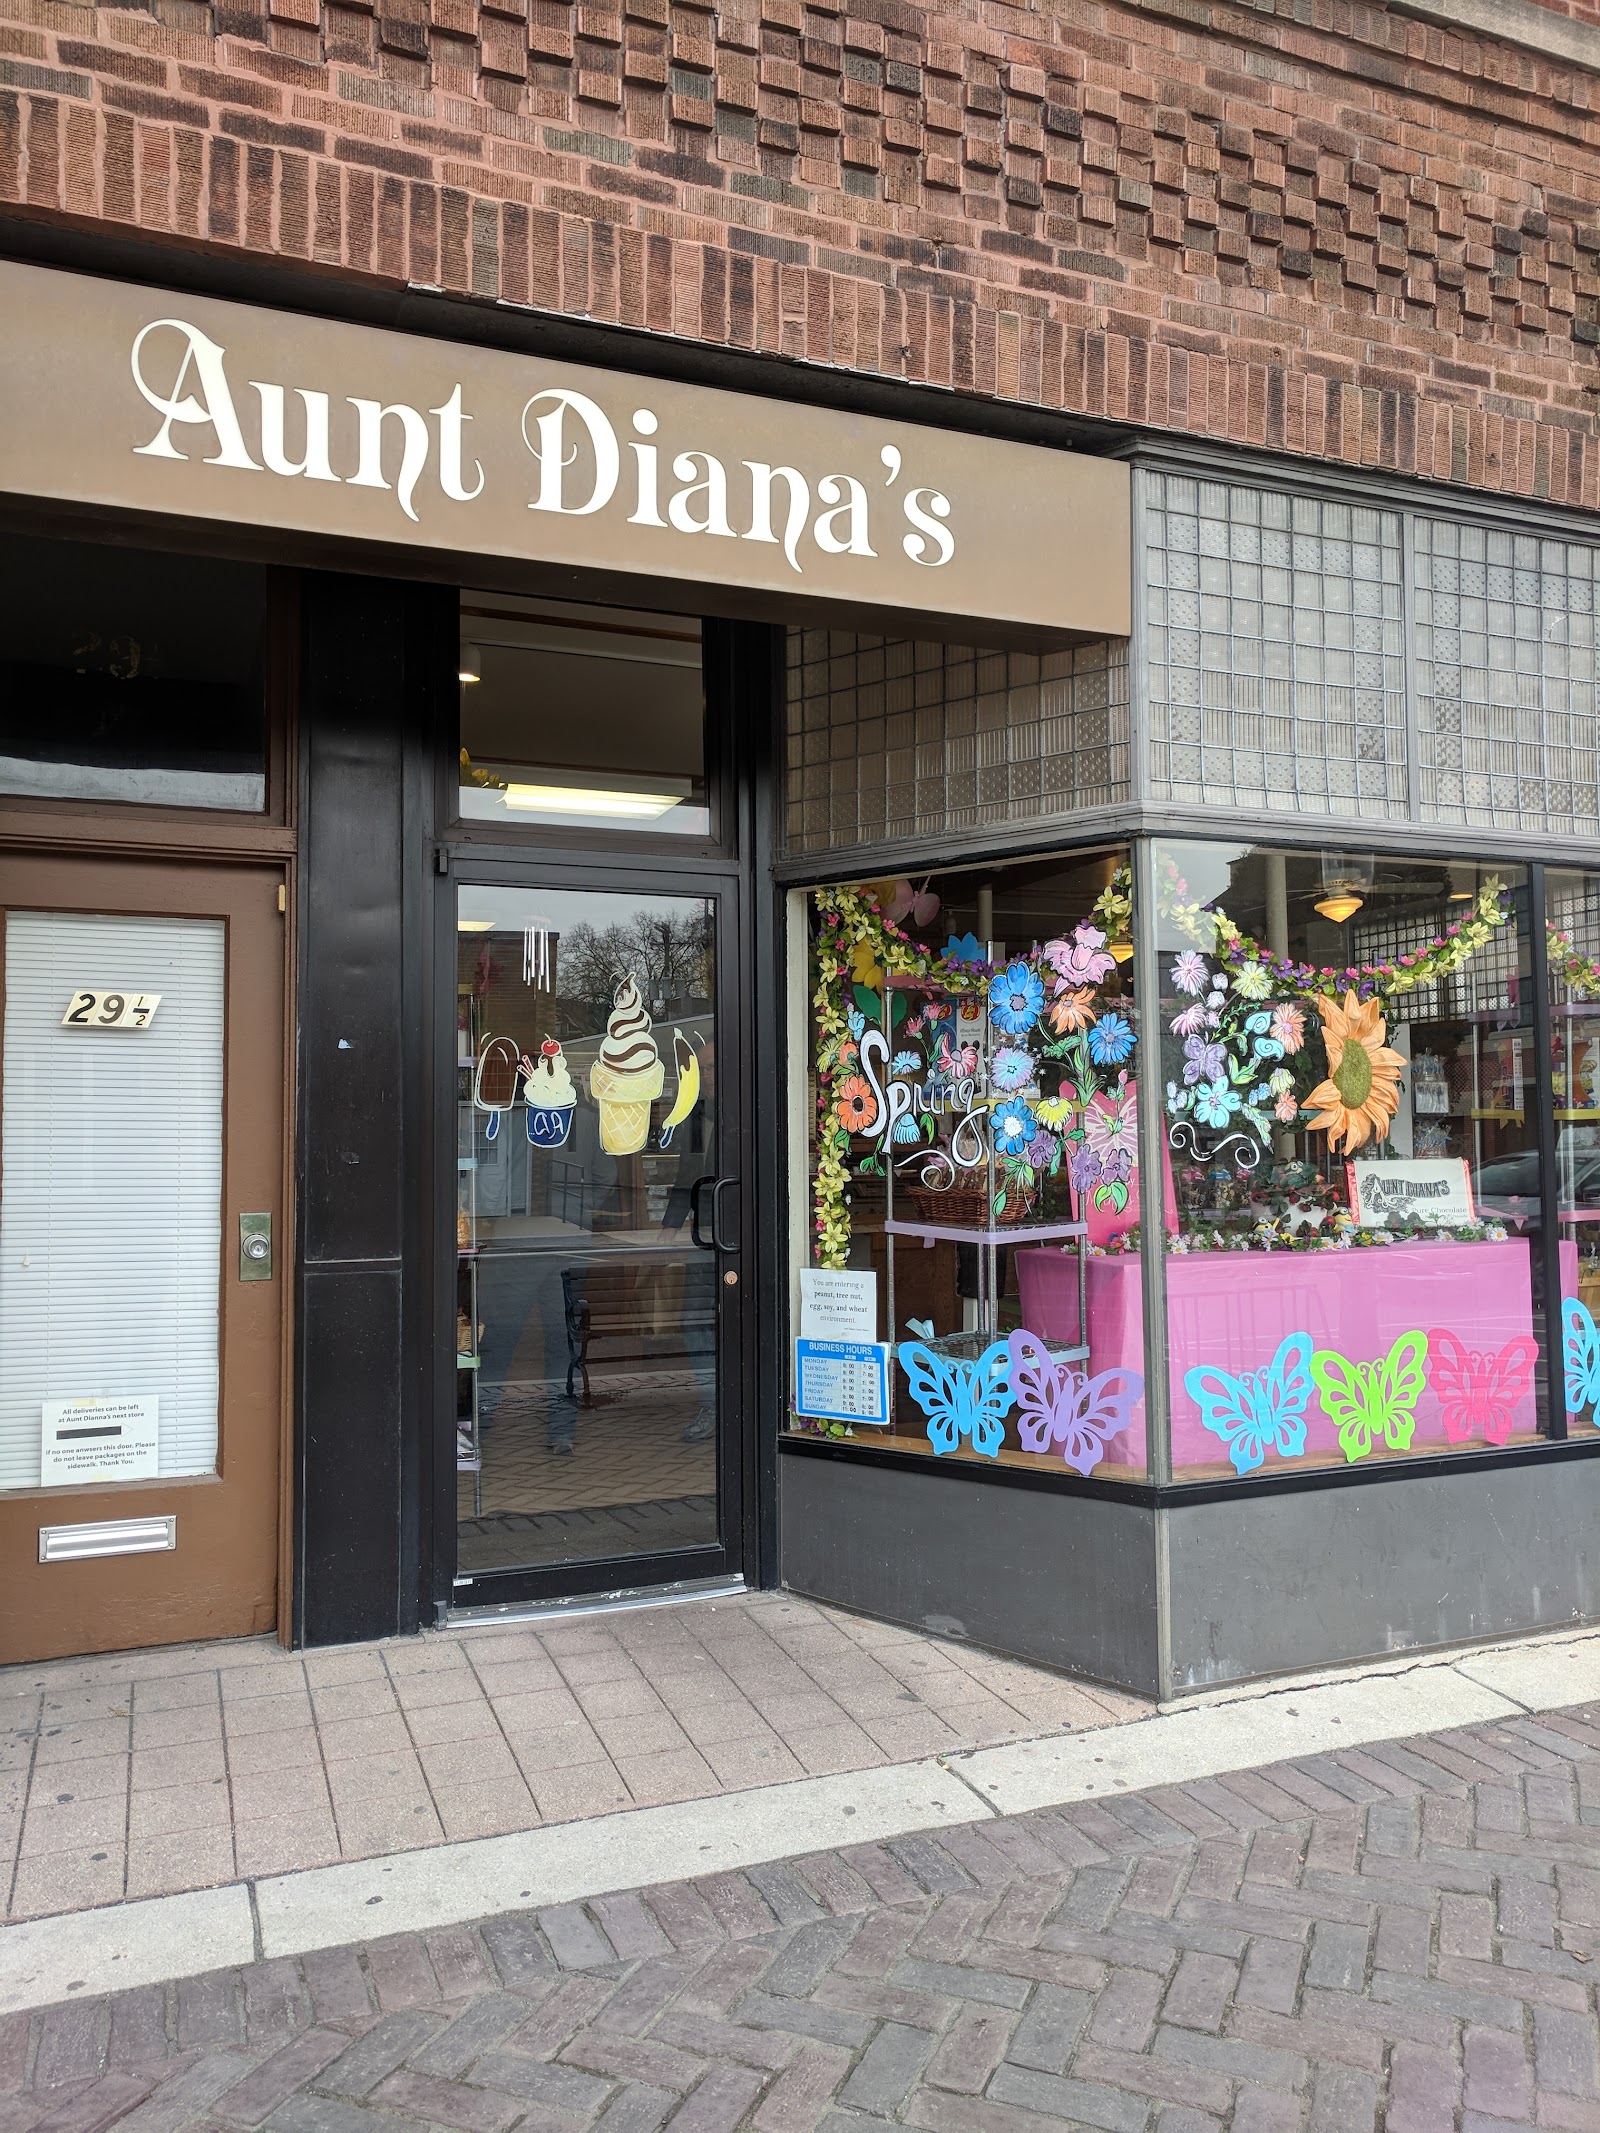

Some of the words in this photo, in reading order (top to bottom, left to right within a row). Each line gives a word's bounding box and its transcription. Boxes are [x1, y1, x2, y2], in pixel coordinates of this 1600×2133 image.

[130, 318, 486, 523] Aunt
[521, 388, 956, 574] Diana's
[858, 1029, 990, 1168] Spring
[1364, 1178, 1405, 1208] AUNT
[1405, 1179, 1451, 1198] DIANA'S
[1430, 1206, 1467, 1214] Chocolate
[813, 1278, 824, 1286] You
[835, 1281, 860, 1290] entering
[809, 1303, 823, 1311] egg,
[809, 1341, 845, 1353] BUSINESS
[846, 1345, 873, 1355] HOURS
[804, 1373, 839, 1381] WEDNESDAY
[805, 1395, 833, 1403] SATURDAY
[94, 1452, 125, 1460] packages
